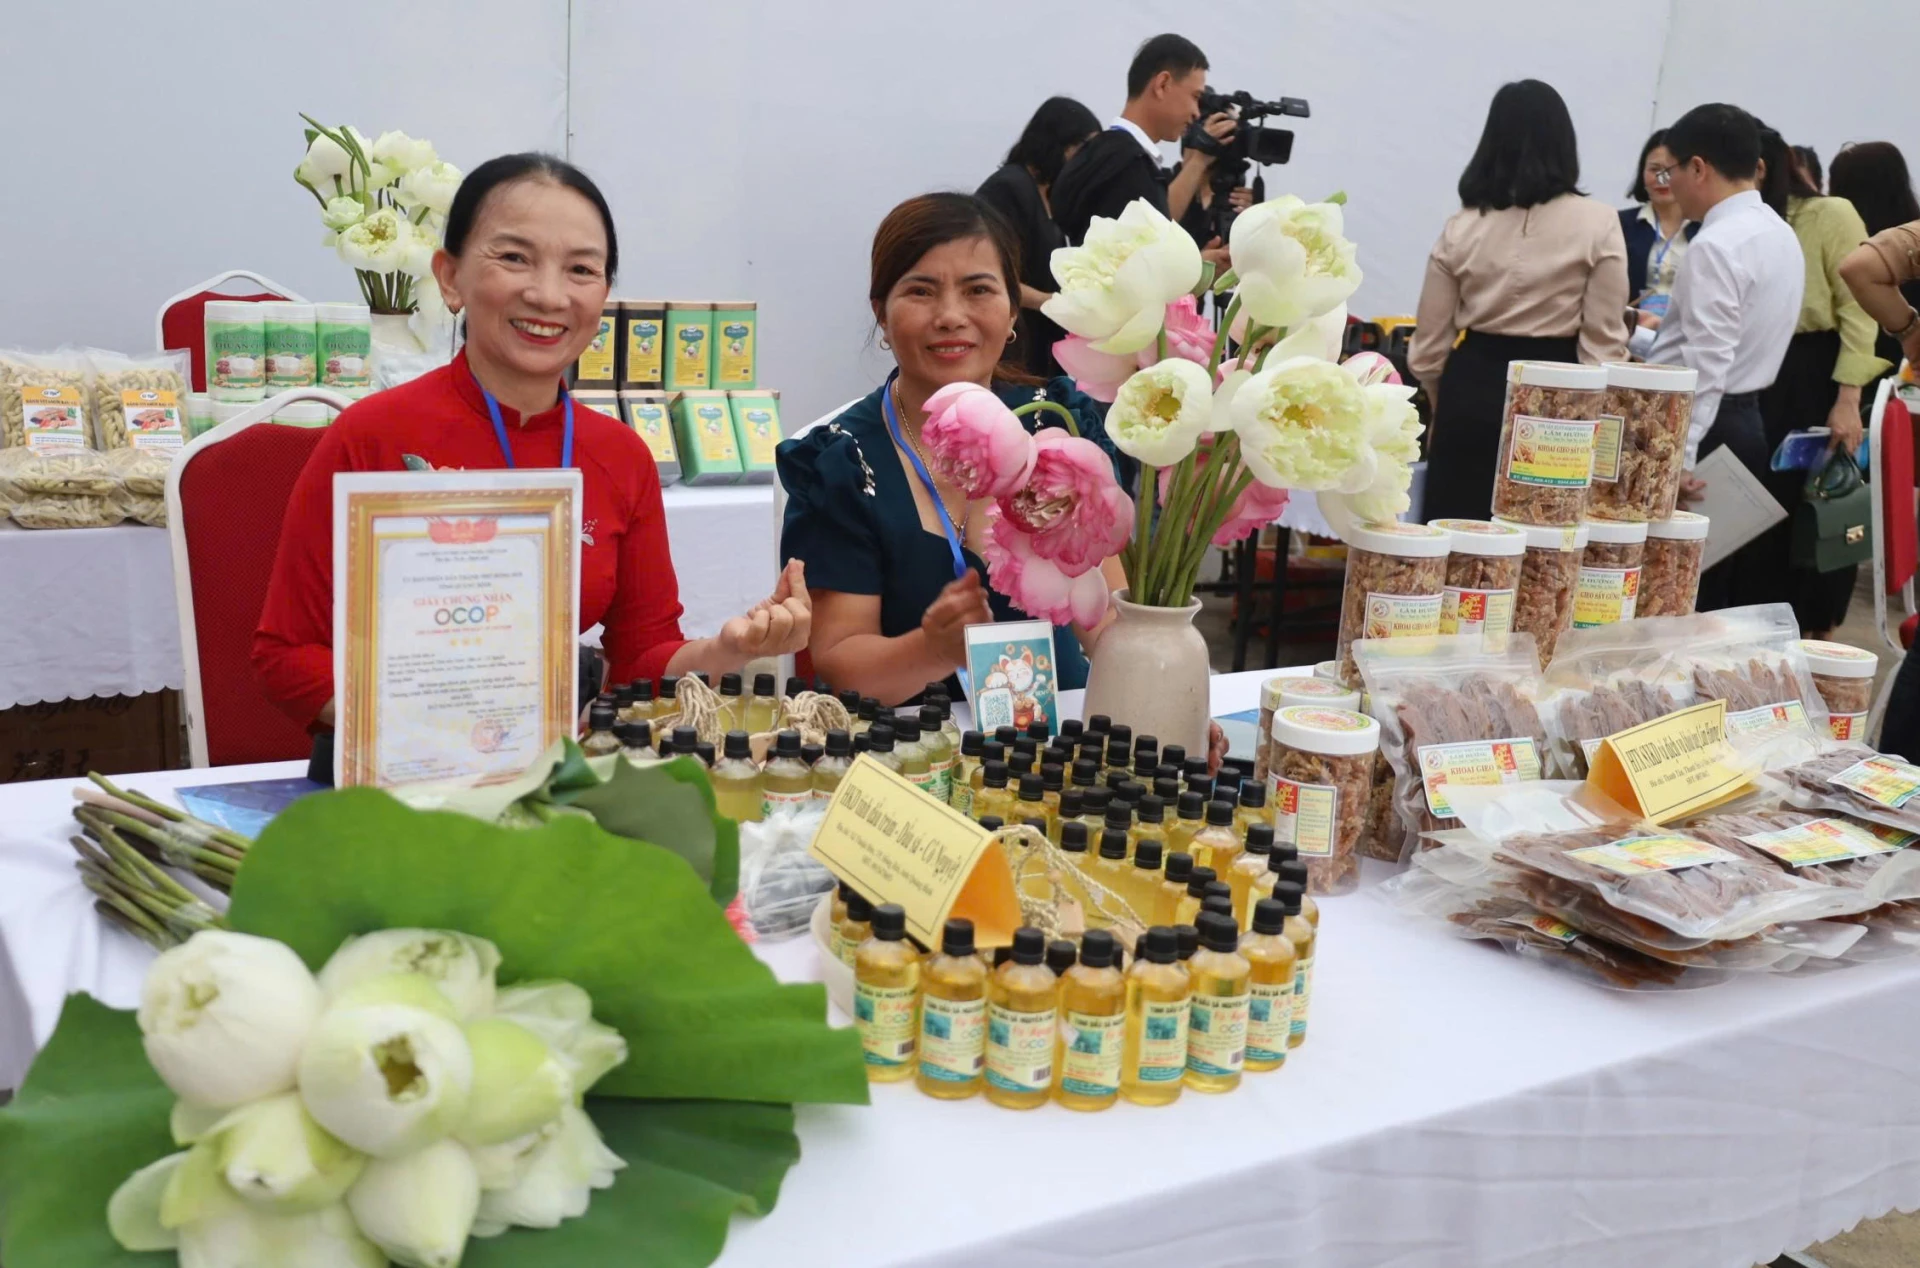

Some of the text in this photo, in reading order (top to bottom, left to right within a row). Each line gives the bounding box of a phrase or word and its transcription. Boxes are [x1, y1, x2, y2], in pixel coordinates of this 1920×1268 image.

[434, 604, 500, 626] OCOP
[1450, 764, 1494, 776] KHOAI GIEO
[839, 783, 860, 811] HKD
[1018, 1037, 1046, 1049] OCO
